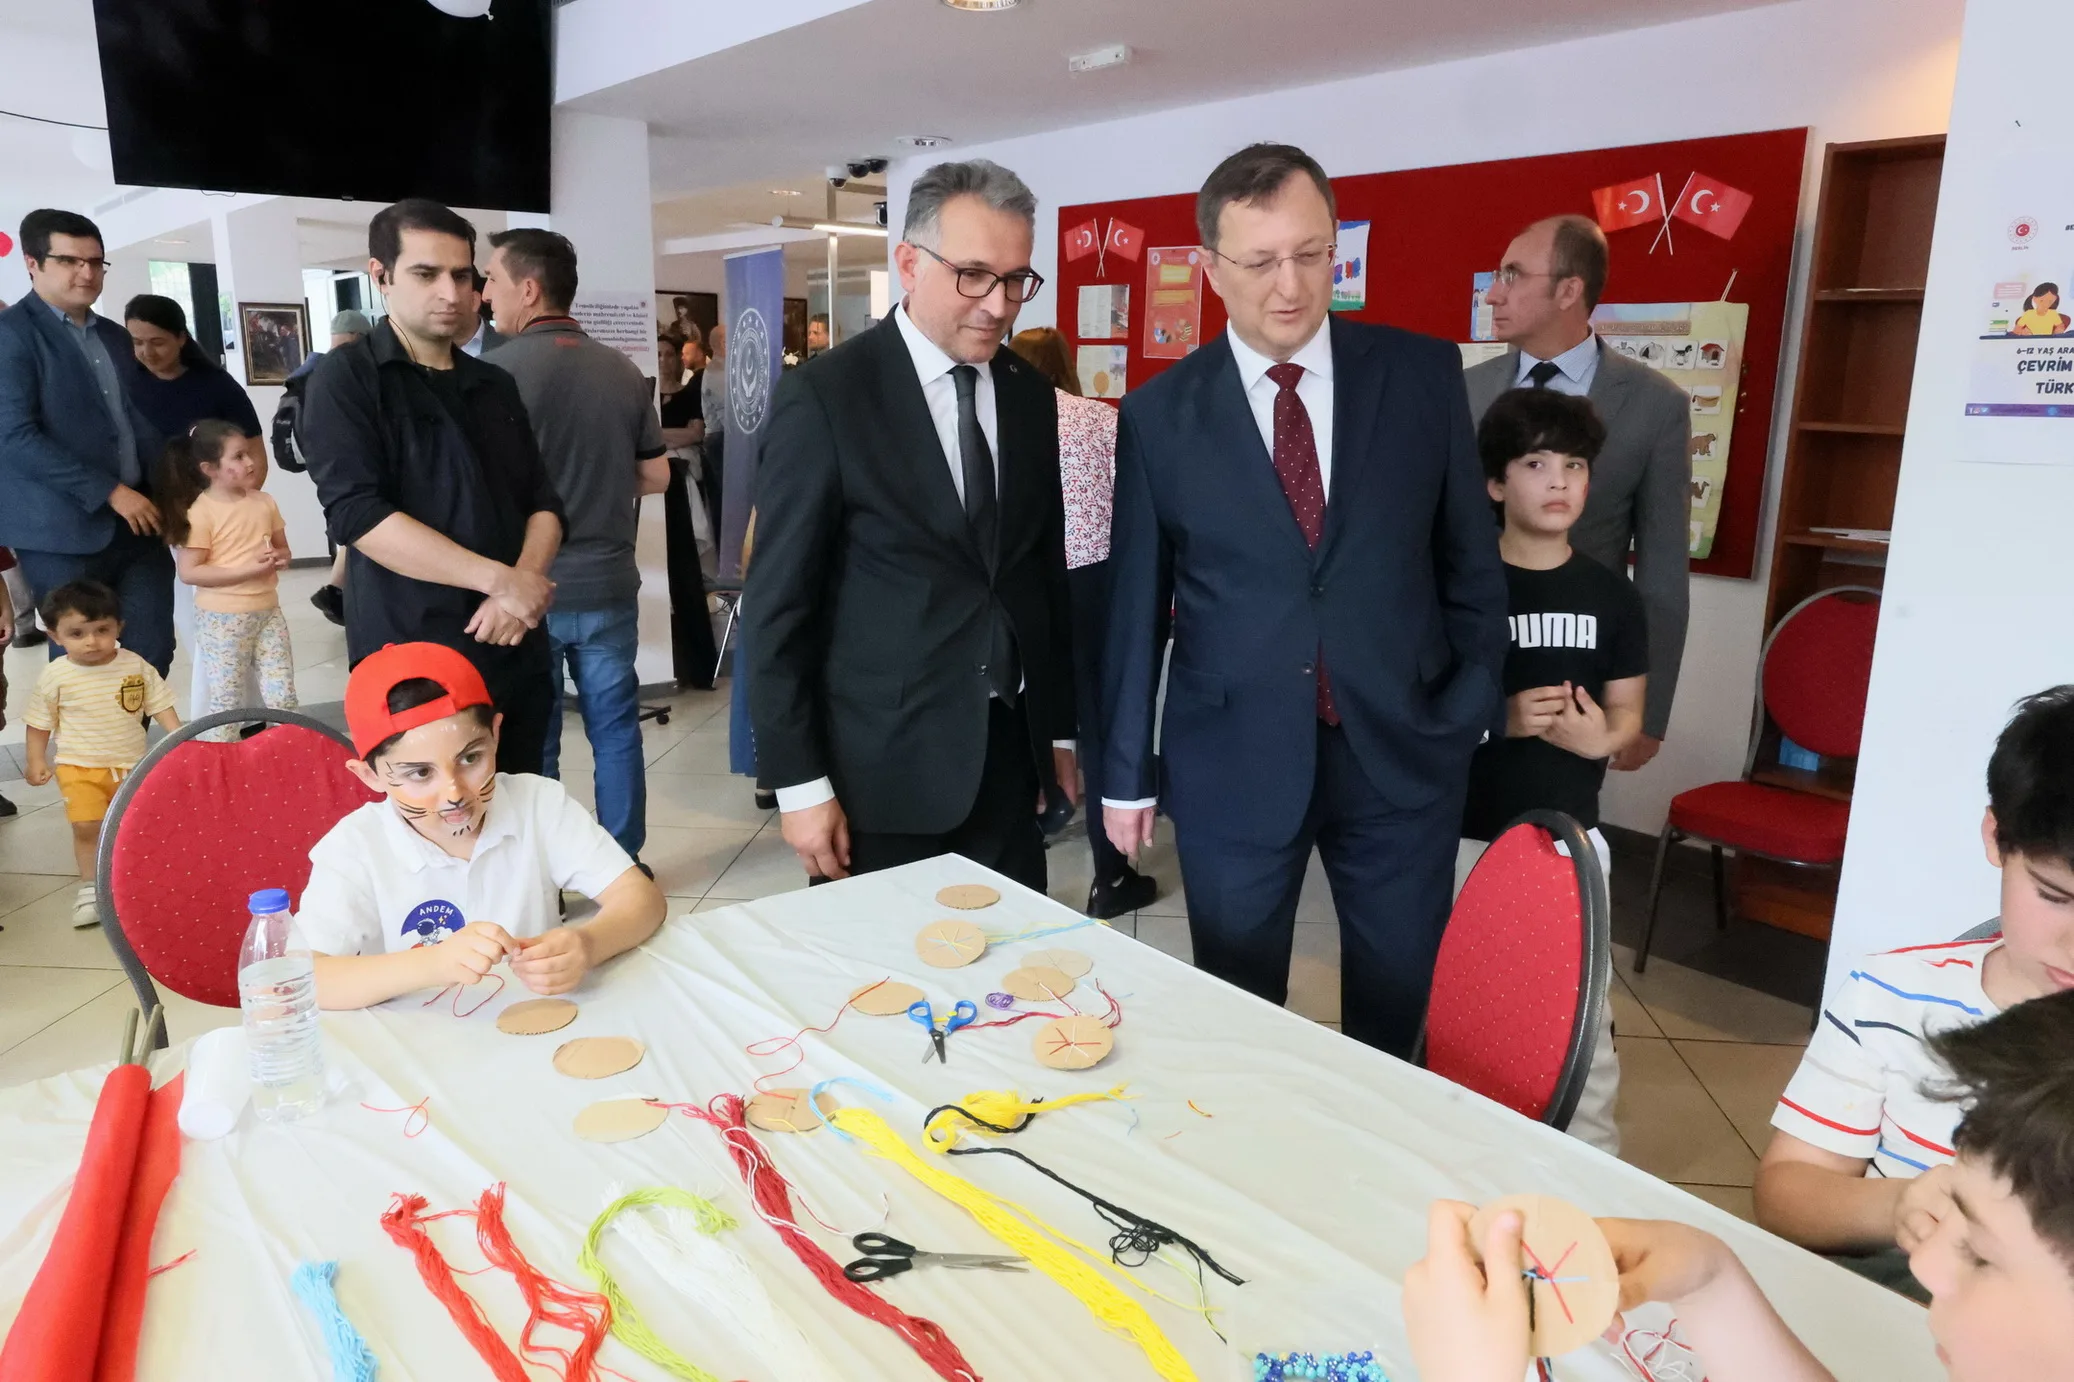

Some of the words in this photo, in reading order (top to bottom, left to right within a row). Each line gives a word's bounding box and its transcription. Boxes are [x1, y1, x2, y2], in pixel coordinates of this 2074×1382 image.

[2037, 347, 2054, 356] YAŞ
[2017, 356, 2073, 375] ÇEVRİM
[2036, 378, 2074, 394] TÜRK
[420, 905, 454, 916] ANDEM
